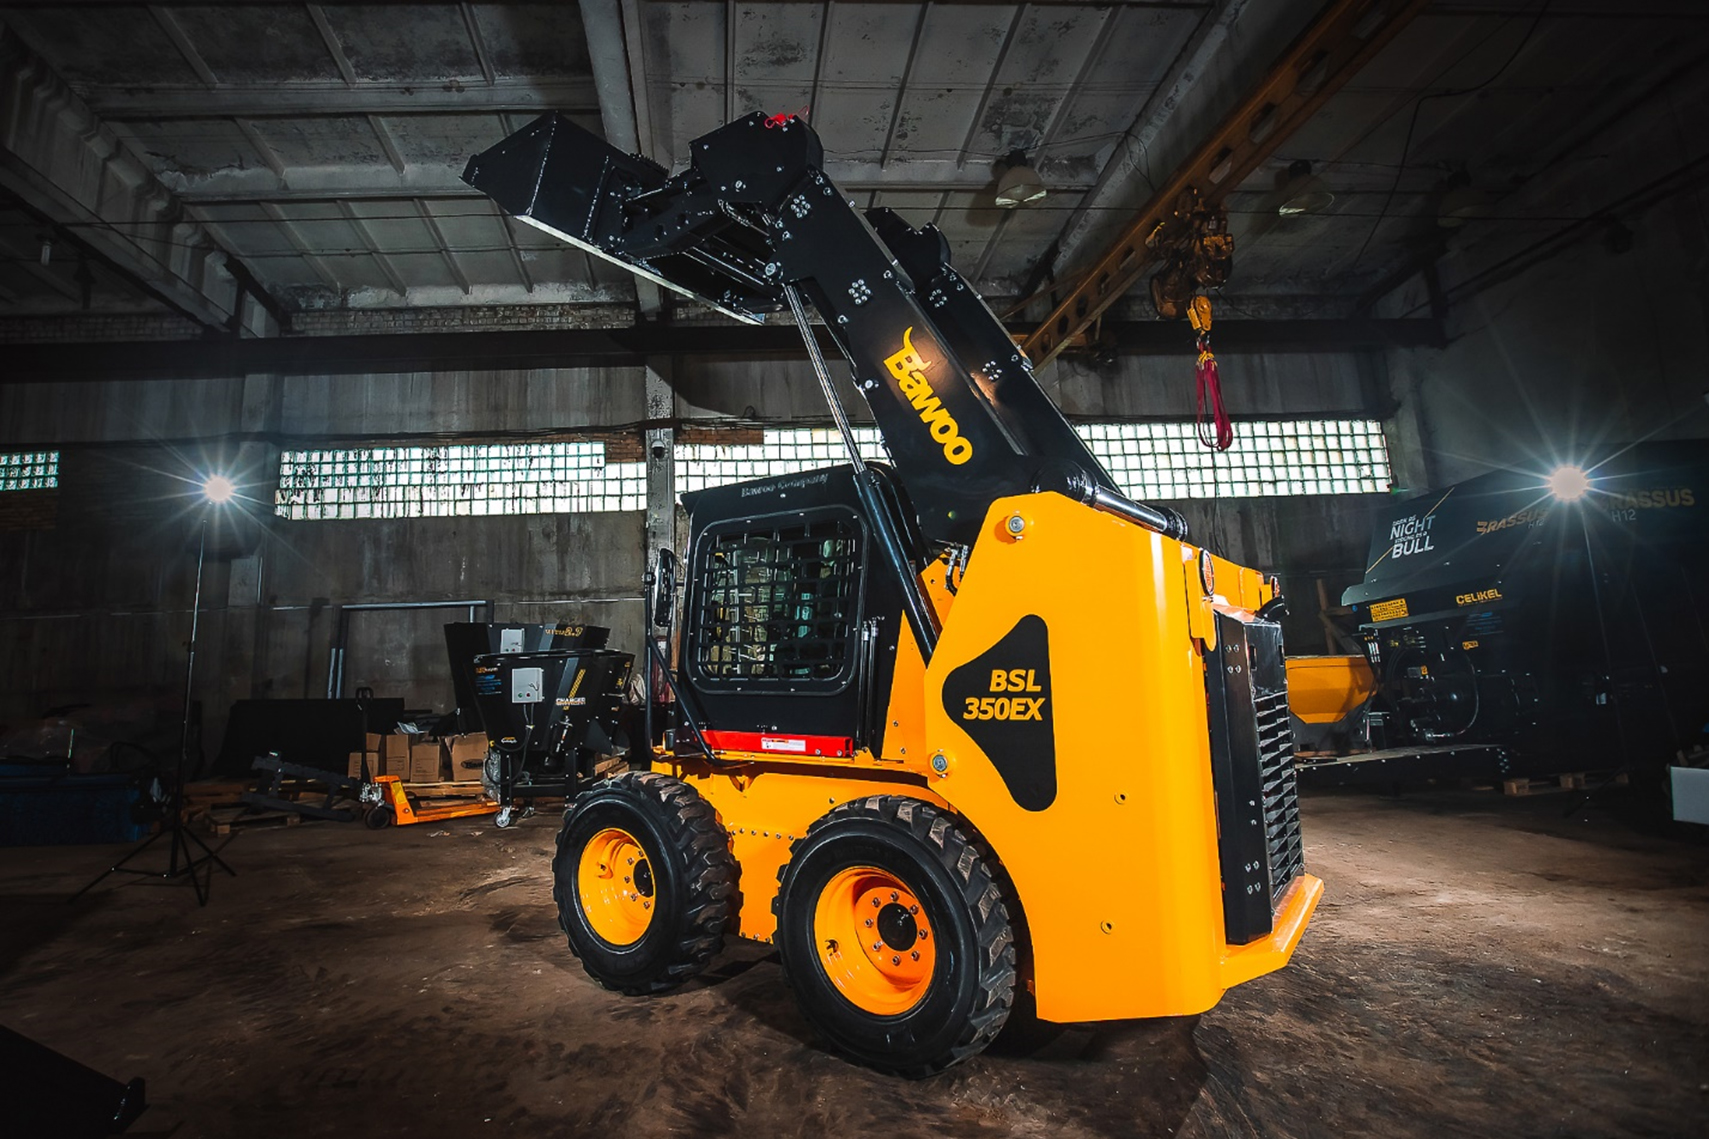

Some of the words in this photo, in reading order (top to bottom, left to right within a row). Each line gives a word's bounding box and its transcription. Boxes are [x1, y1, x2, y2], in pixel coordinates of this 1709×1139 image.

[1611, 508, 1637, 522] H12
[1390, 515, 1436, 540] NIGHT
[1392, 536, 1434, 559] BULL
[989, 669, 1042, 692] BSL
[963, 697, 1046, 721] 350EX
